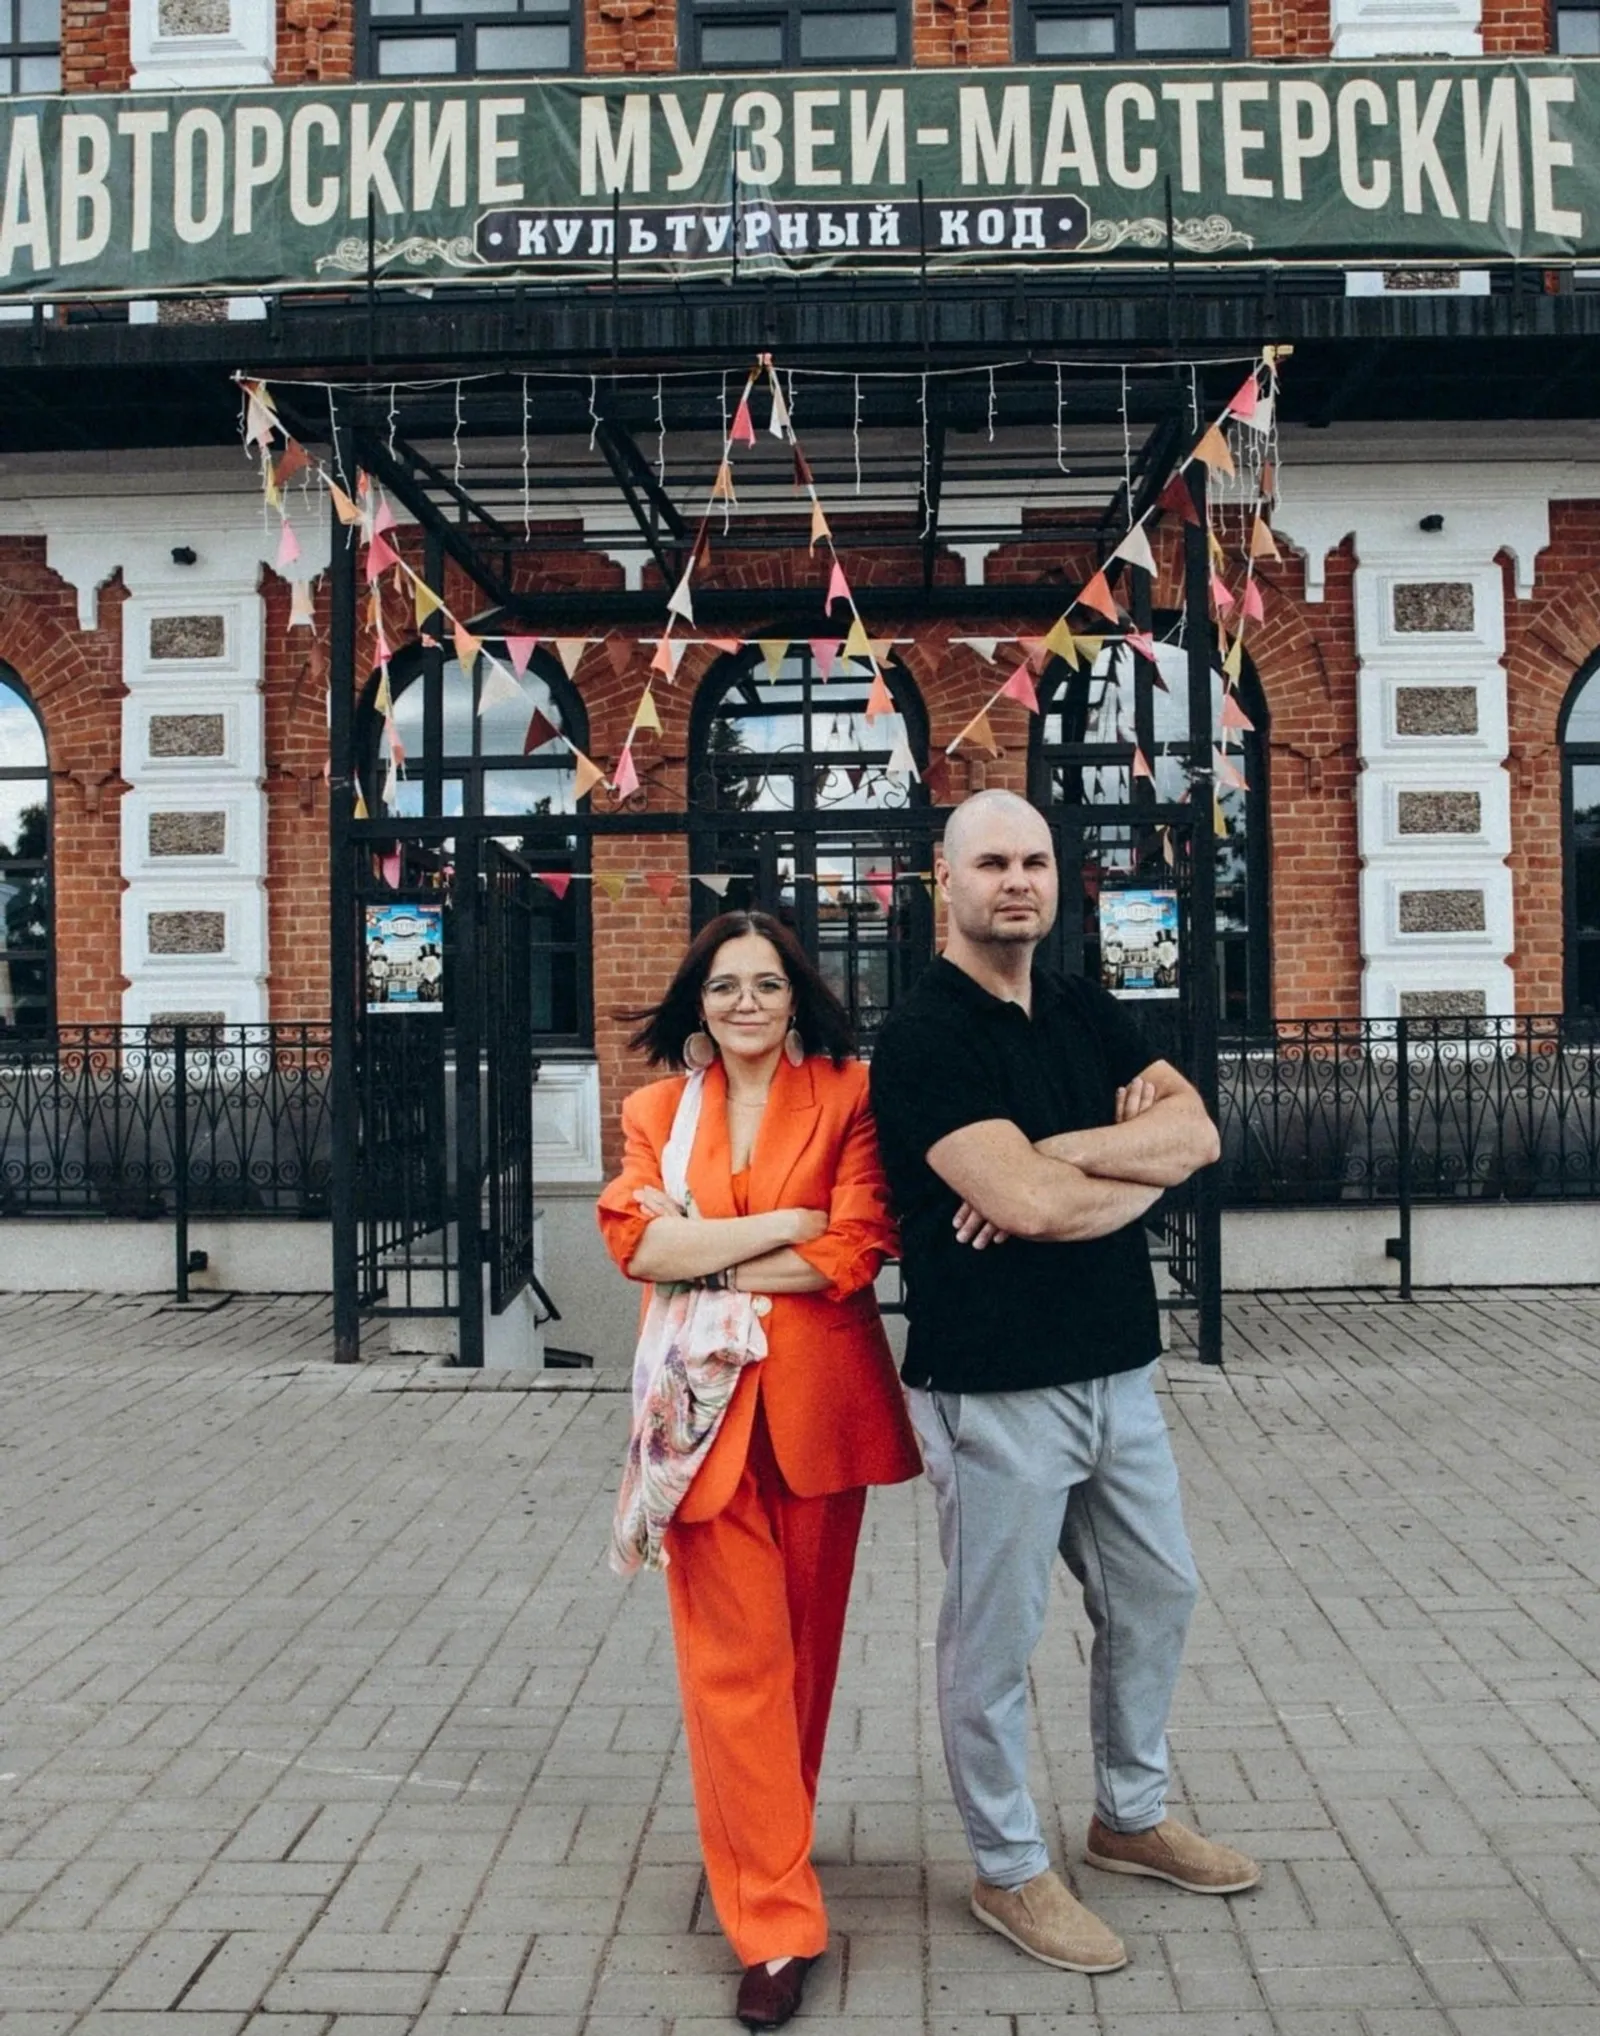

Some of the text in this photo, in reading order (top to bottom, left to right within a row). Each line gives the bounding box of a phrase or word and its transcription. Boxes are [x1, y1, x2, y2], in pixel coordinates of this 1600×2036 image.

[0, 76, 1583, 276] АВТОРСКИЕ МУЗЕИ-МАСТЕРСКИЕ
[517, 204, 1046, 256] КУЛЬТУРНЫЙ КОД
